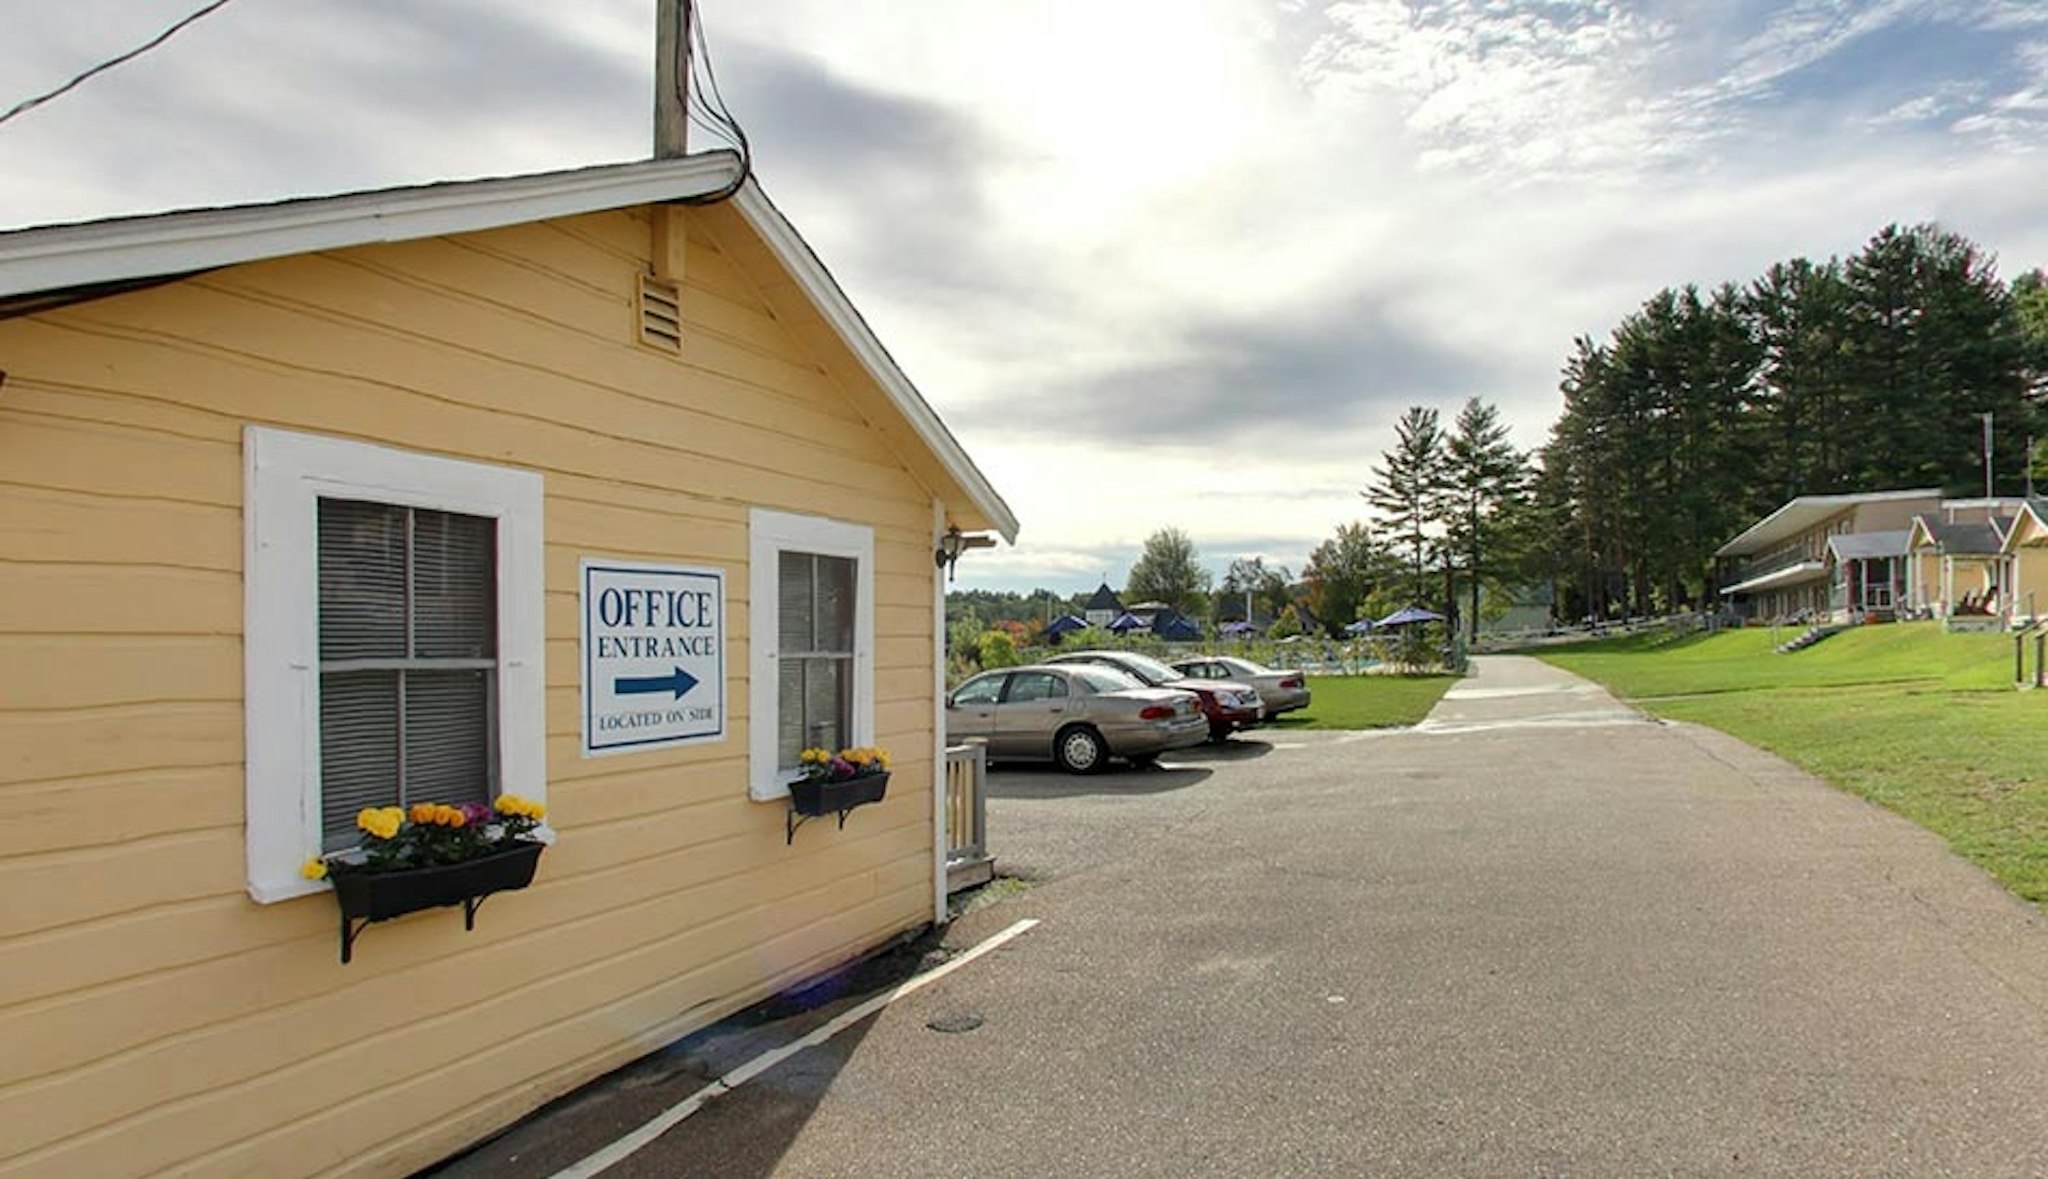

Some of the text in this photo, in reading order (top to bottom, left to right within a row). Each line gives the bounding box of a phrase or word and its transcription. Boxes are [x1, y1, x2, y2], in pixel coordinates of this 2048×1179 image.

[600, 587, 713, 628] OFFICE
[598, 636, 715, 659] ENTRANCE
[600, 708, 713, 730] LOCATED ON SIDE
